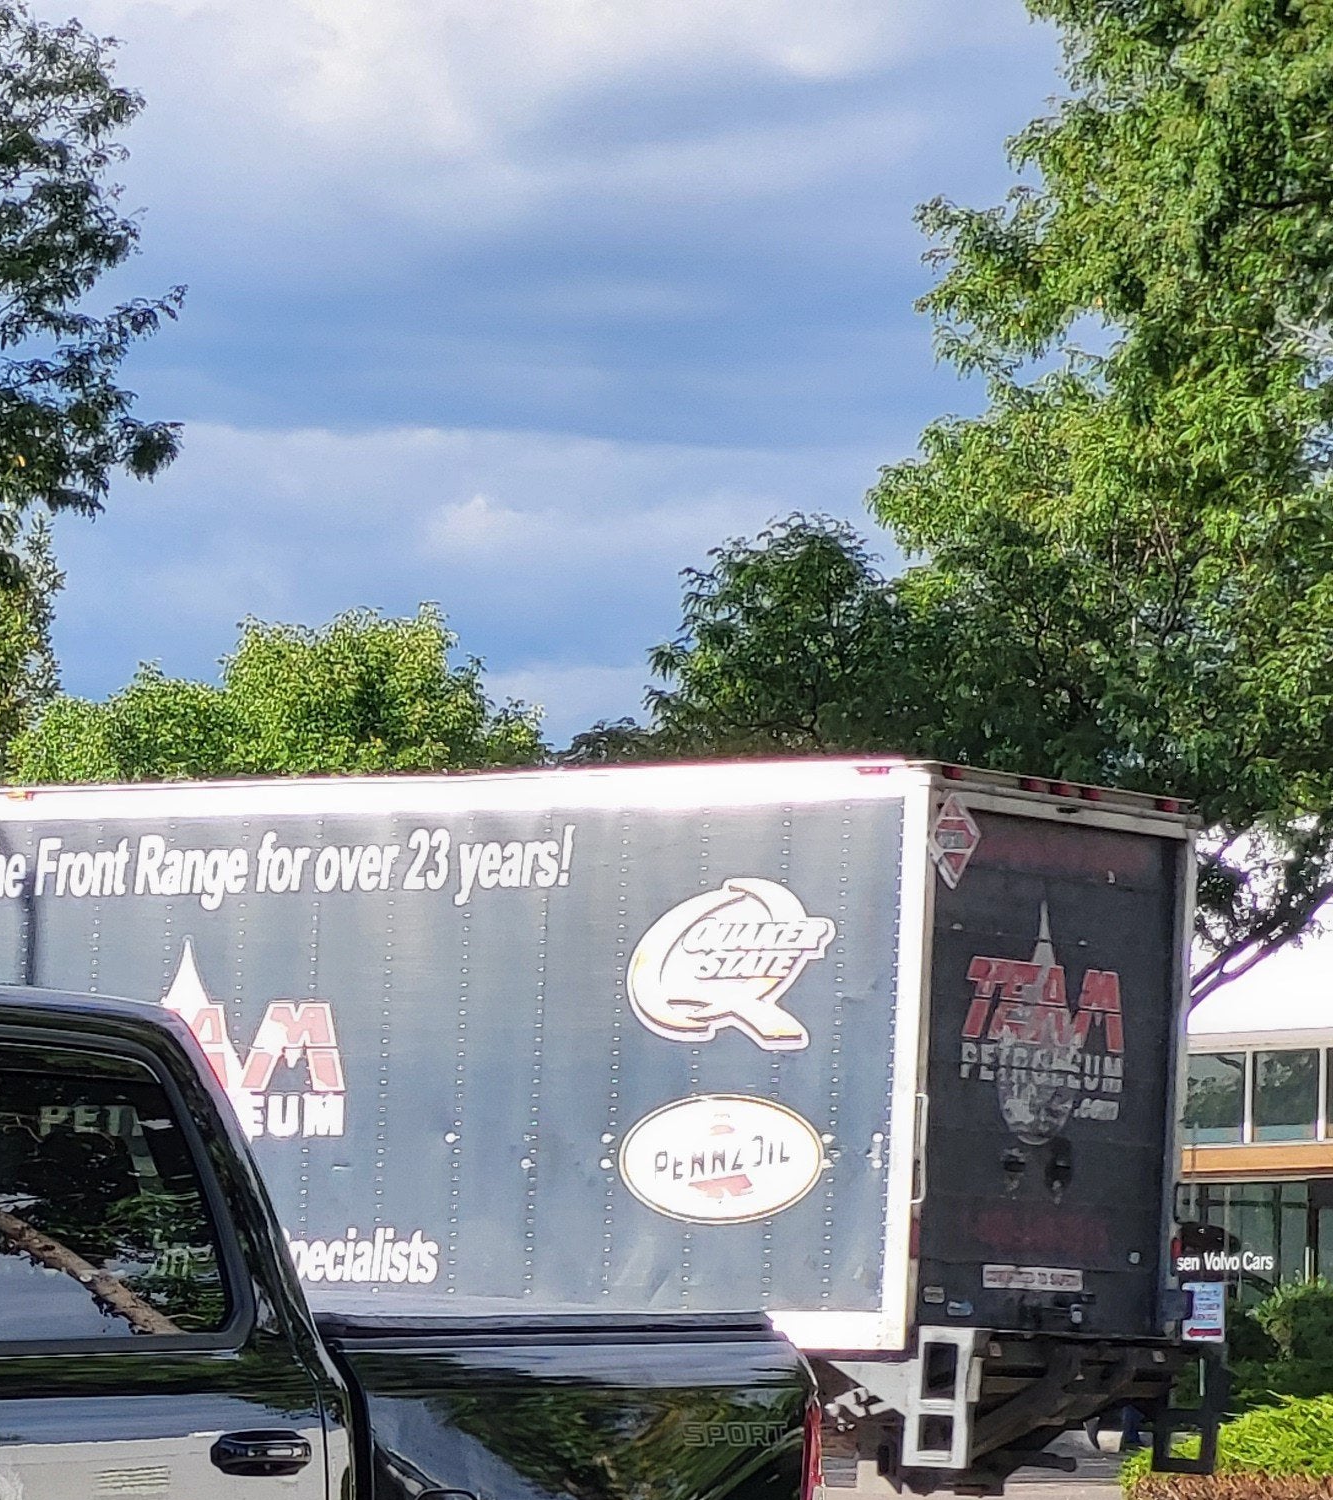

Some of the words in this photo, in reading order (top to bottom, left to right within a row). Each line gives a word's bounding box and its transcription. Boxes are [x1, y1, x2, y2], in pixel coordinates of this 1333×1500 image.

[35, 837, 131, 897] Front
[134, 833, 249, 911] Range
[255, 830, 311, 893] for
[315, 844, 401, 893] over
[402, 827, 451, 891] 23
[453, 824, 576, 907] years!
[683, 918, 828, 951] QUAKER
[695, 950, 799, 980] STATE
[961, 955, 1124, 1054] TEAM
[283, 1227, 439, 1283] pecialists
[1203, 1251, 1240, 1271] Volvo
[1242, 1251, 1274, 1271] Cars
[682, 1421, 788, 1447] SPORT
